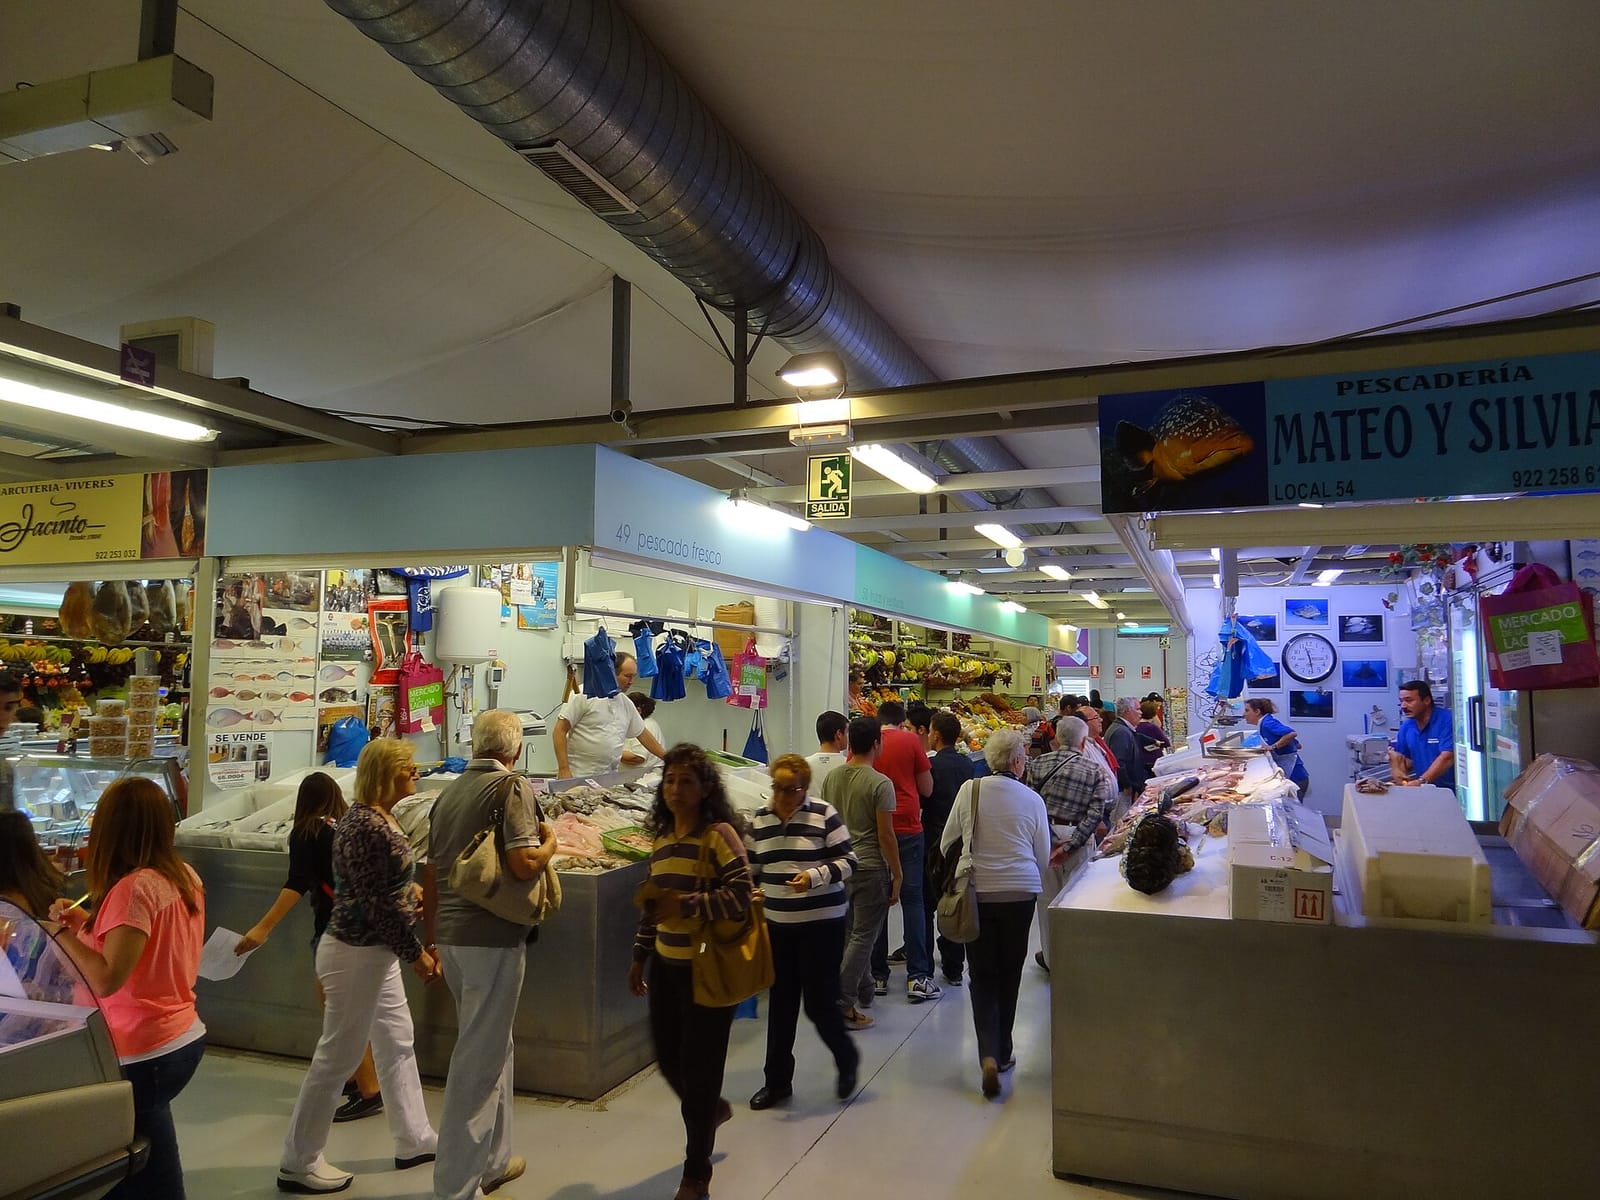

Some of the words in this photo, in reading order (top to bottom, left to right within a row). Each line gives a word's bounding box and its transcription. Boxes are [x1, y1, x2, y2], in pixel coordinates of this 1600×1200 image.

[1336, 362, 1534, 396] PESCADERÍA
[1273, 405, 1413, 466] MATEO
[1425, 401, 1453, 456] Y
[1469, 389, 1600, 453] SILVIA
[66, 479, 114, 490] VIVERES
[1512, 469, 1543, 488] 922
[1548, 467, 1580, 485] 258
[1274, 481, 1330, 500] LOCAL
[1336, 480, 1355, 497] 54
[811, 503, 846, 512] SALIDA
[0, 503, 88, 553] Jacinto
[615, 523, 631, 544] 49
[637, 530, 689, 558] pescado
[692, 541, 722, 565] fresco
[95, 551, 108, 560] 922
[109, 550, 122, 559] 253
[124, 549, 137, 558] 032
[1498, 606, 1576, 629] MERCADO
[410, 684, 440, 697] MERCADO
[411, 698, 436, 710] LAGUNA
[215, 734, 229, 742] SE
[232, 733, 267, 741] VENDE
